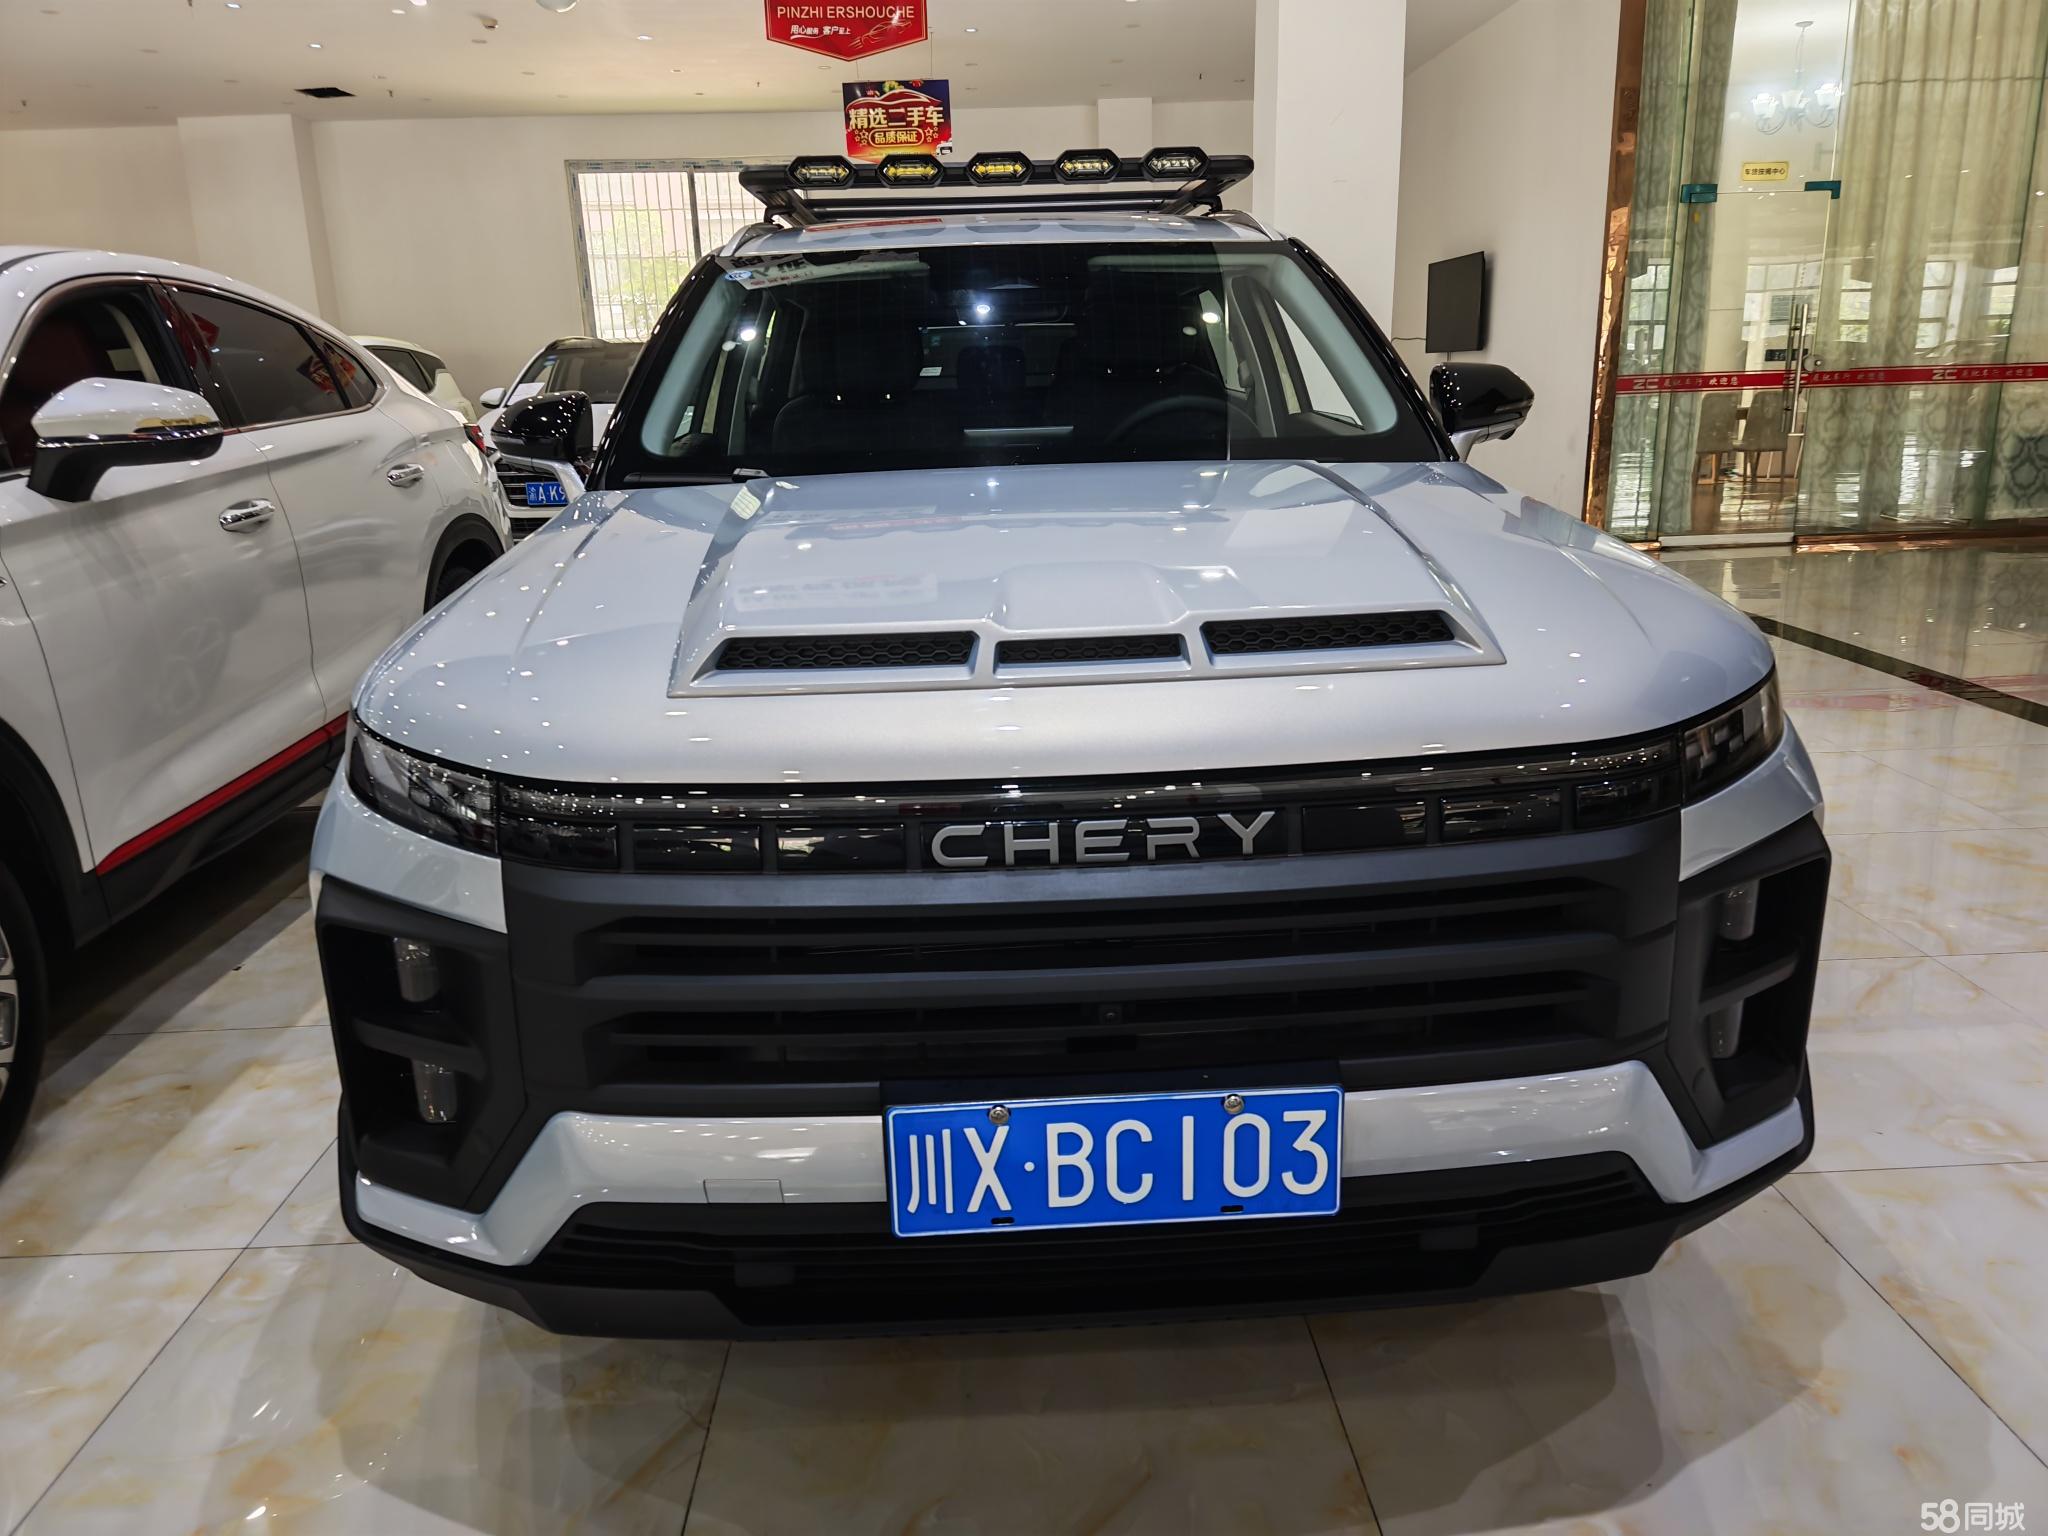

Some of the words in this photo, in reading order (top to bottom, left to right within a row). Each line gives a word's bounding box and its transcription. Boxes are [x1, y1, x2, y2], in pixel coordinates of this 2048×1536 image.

[777, 6, 823, 19] PINZHI
[826, 5, 915, 19] ERSHOUCHE
[848, 105, 945, 130] 精选二手车
[874, 130, 919, 144] 品质保证
[931, 811, 1276, 868] CHERY
[907, 1109, 1329, 1214] 川X·BC103
